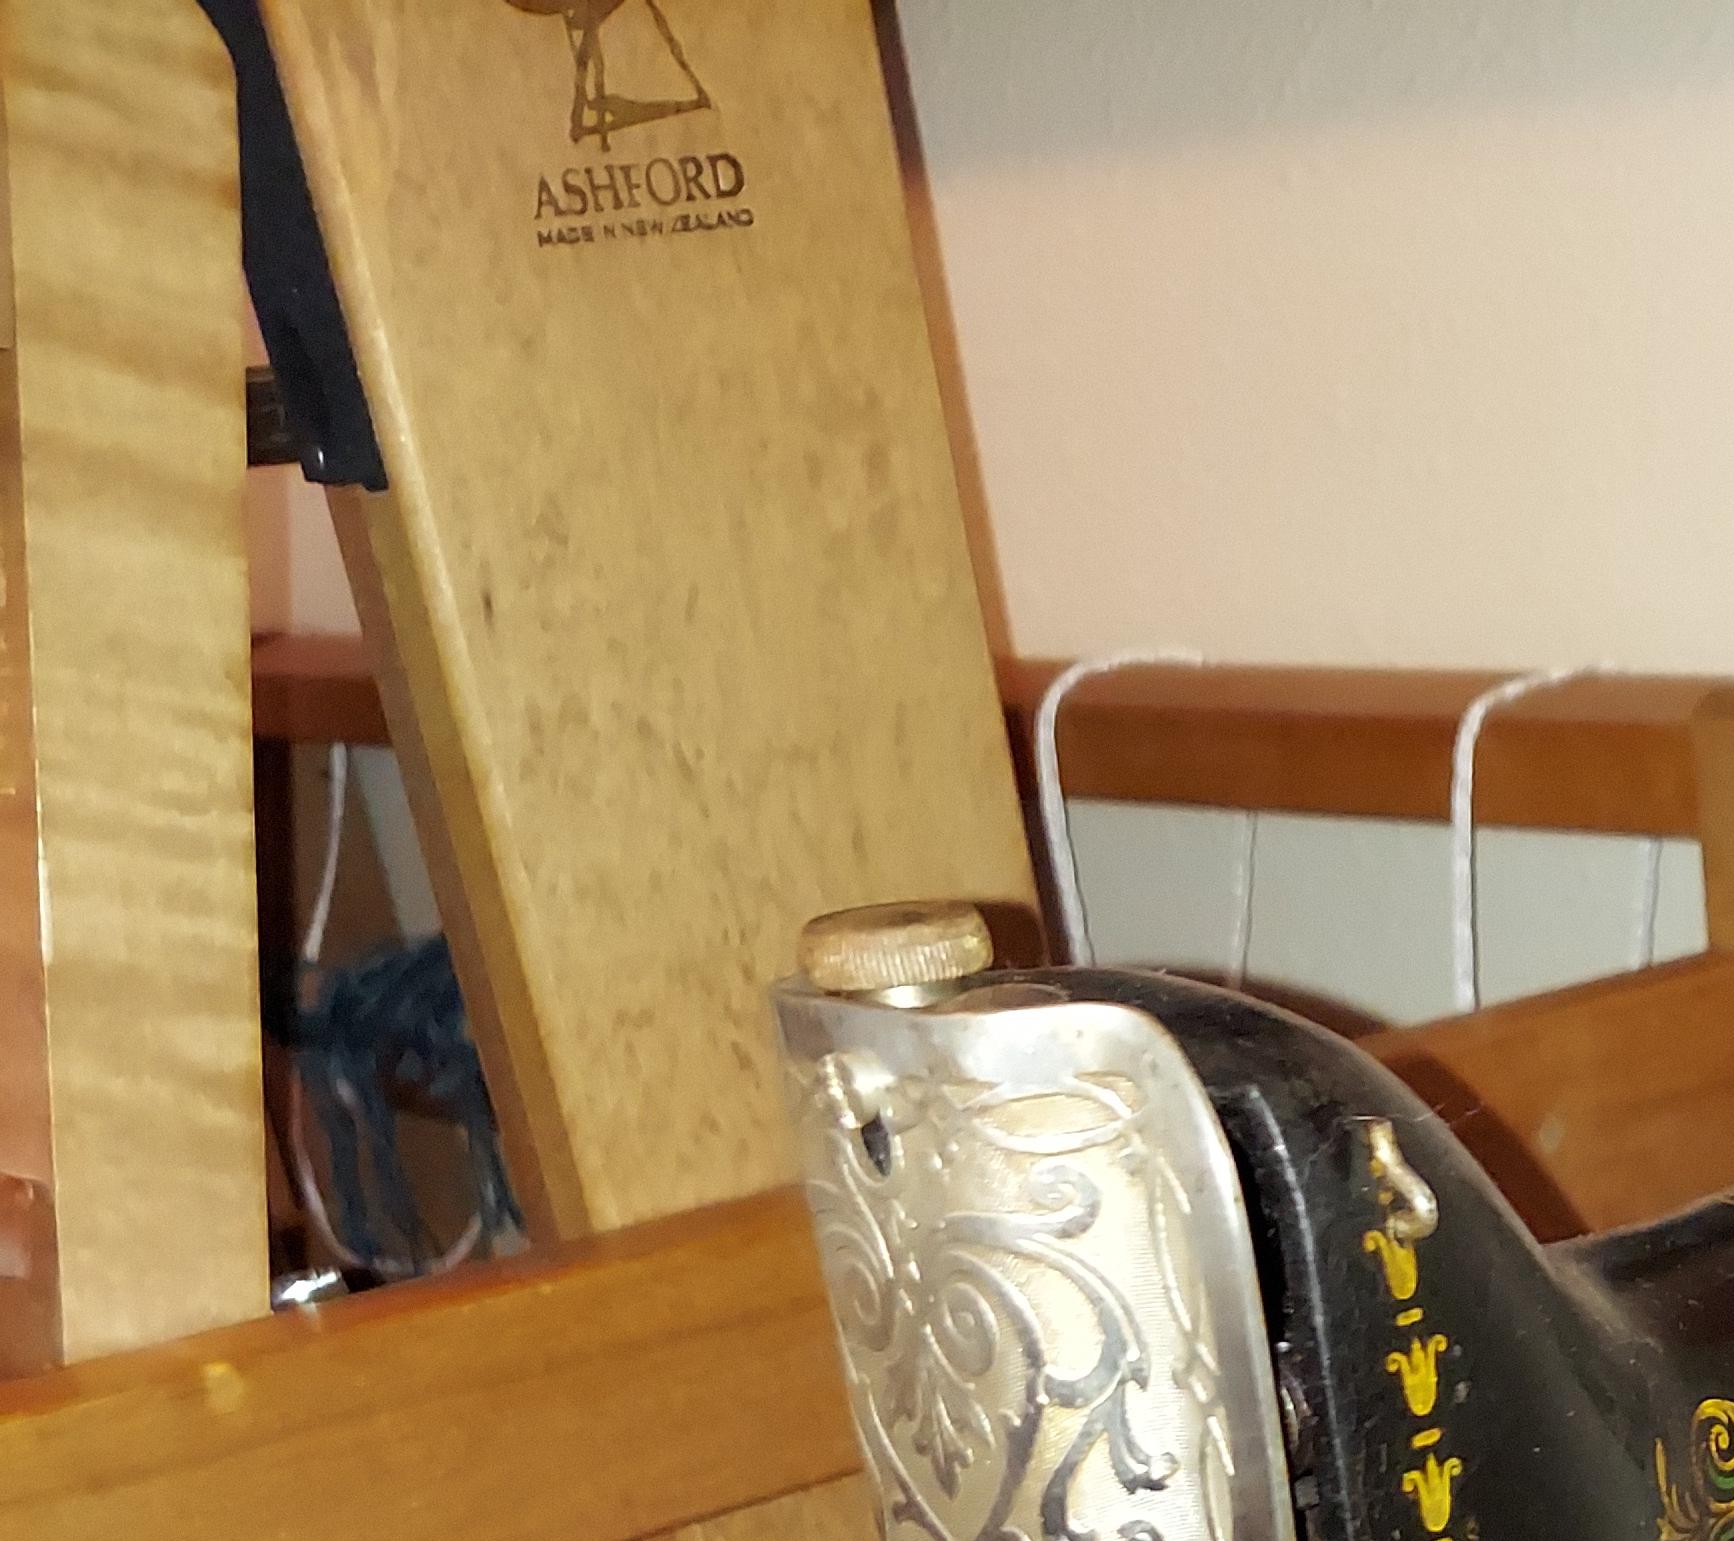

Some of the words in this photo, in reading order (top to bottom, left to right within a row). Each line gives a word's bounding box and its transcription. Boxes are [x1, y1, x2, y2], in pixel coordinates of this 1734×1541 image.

[534, 153, 745, 219] ASHFORD
[537, 225, 595, 248] MADE
[620, 219, 664, 238] NEW
